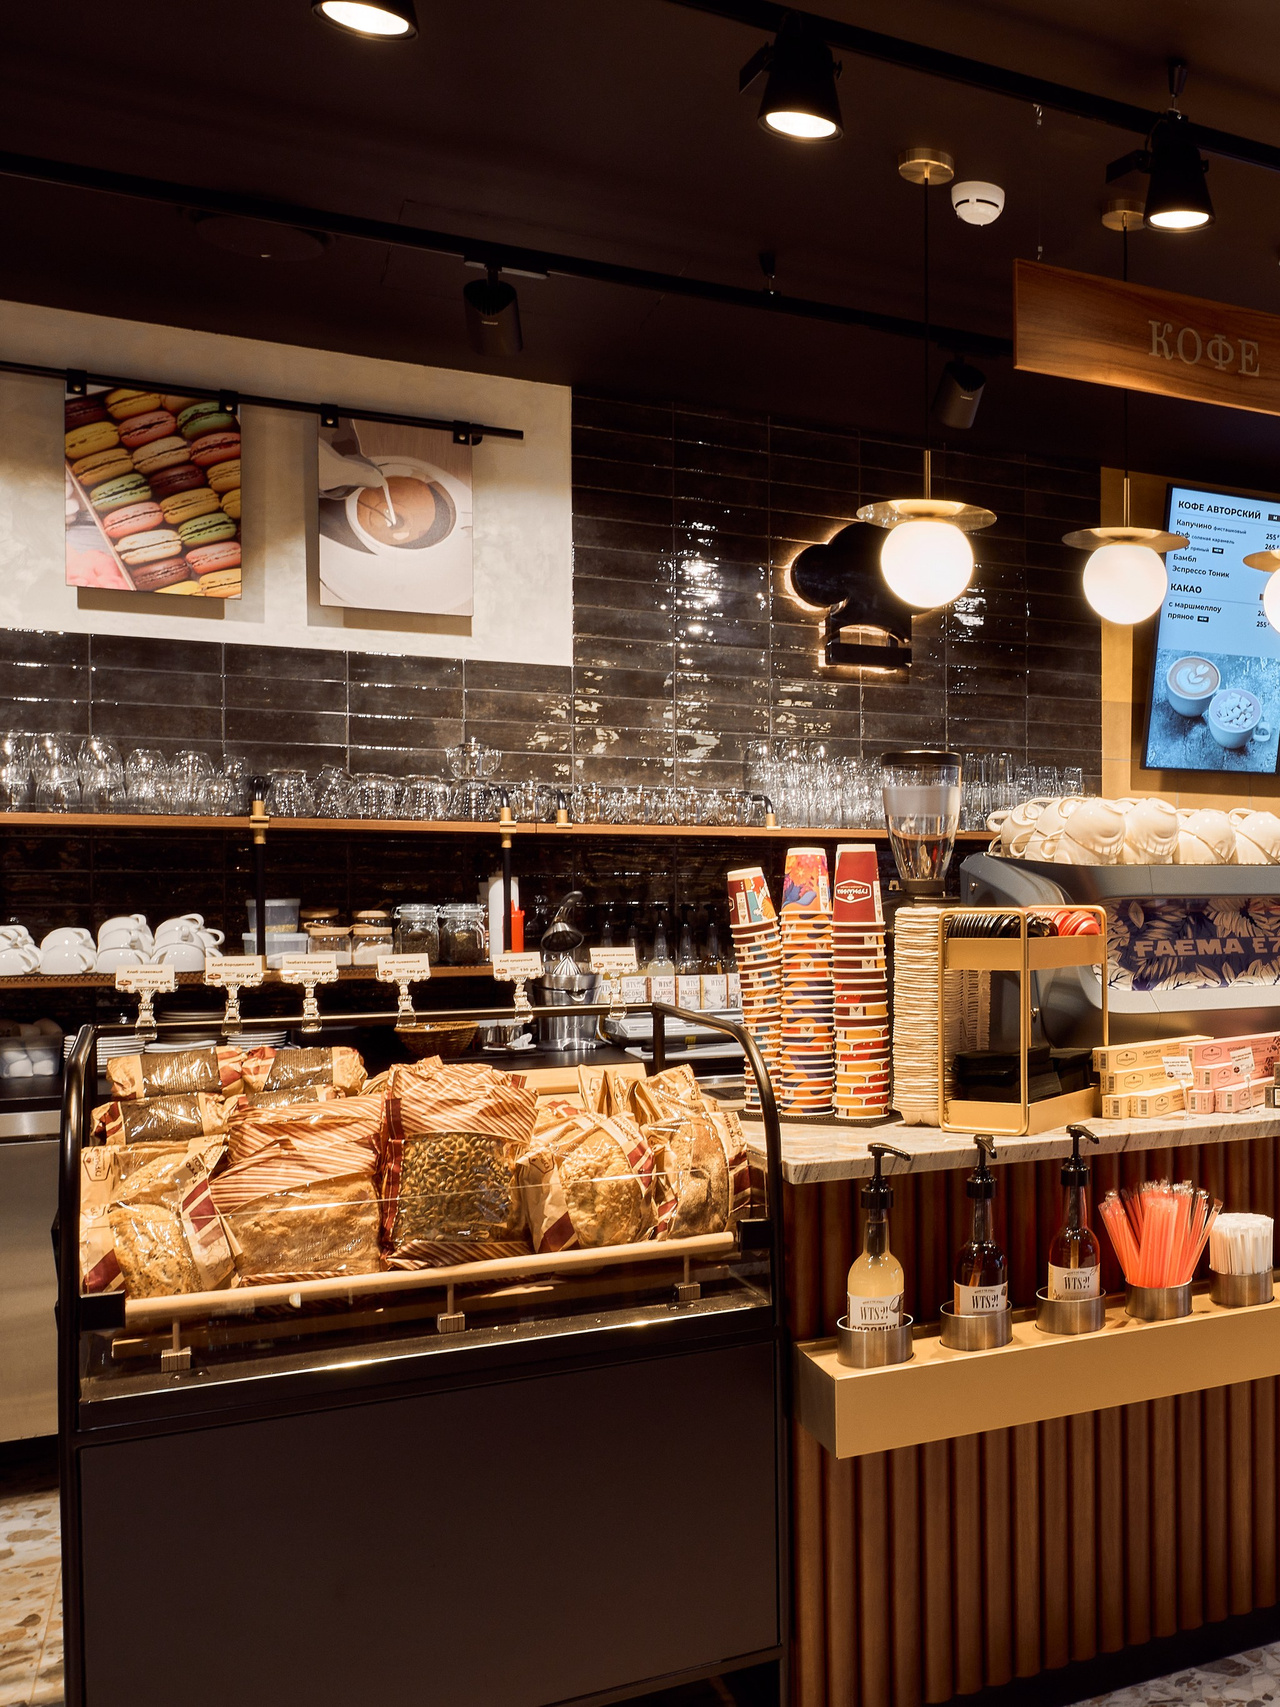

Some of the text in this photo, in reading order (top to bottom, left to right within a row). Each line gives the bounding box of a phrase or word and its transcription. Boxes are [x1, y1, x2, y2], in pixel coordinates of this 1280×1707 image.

[1148, 320, 1260, 377] КОФЕ
[1178, 501, 1261, 520] КОФЕ АВТОРСКИЙ
[1176, 519, 1212, 530] Капучино
[1173, 553, 1197, 563] Бамбл
[1172, 564, 1230, 578] Эспрессо Тоник
[1170, 583, 1202, 594] КАКАО
[1174, 602, 1222, 613] маршмеллоу
[1167, 612, 1194, 621] пряное
[1133, 938, 1245, 957] FAEMA
[1064, 1276, 1090, 1290] WTS?!
[971, 1294, 999, 1309] WTS?!
[860, 1306, 889, 1320] WTS?!
